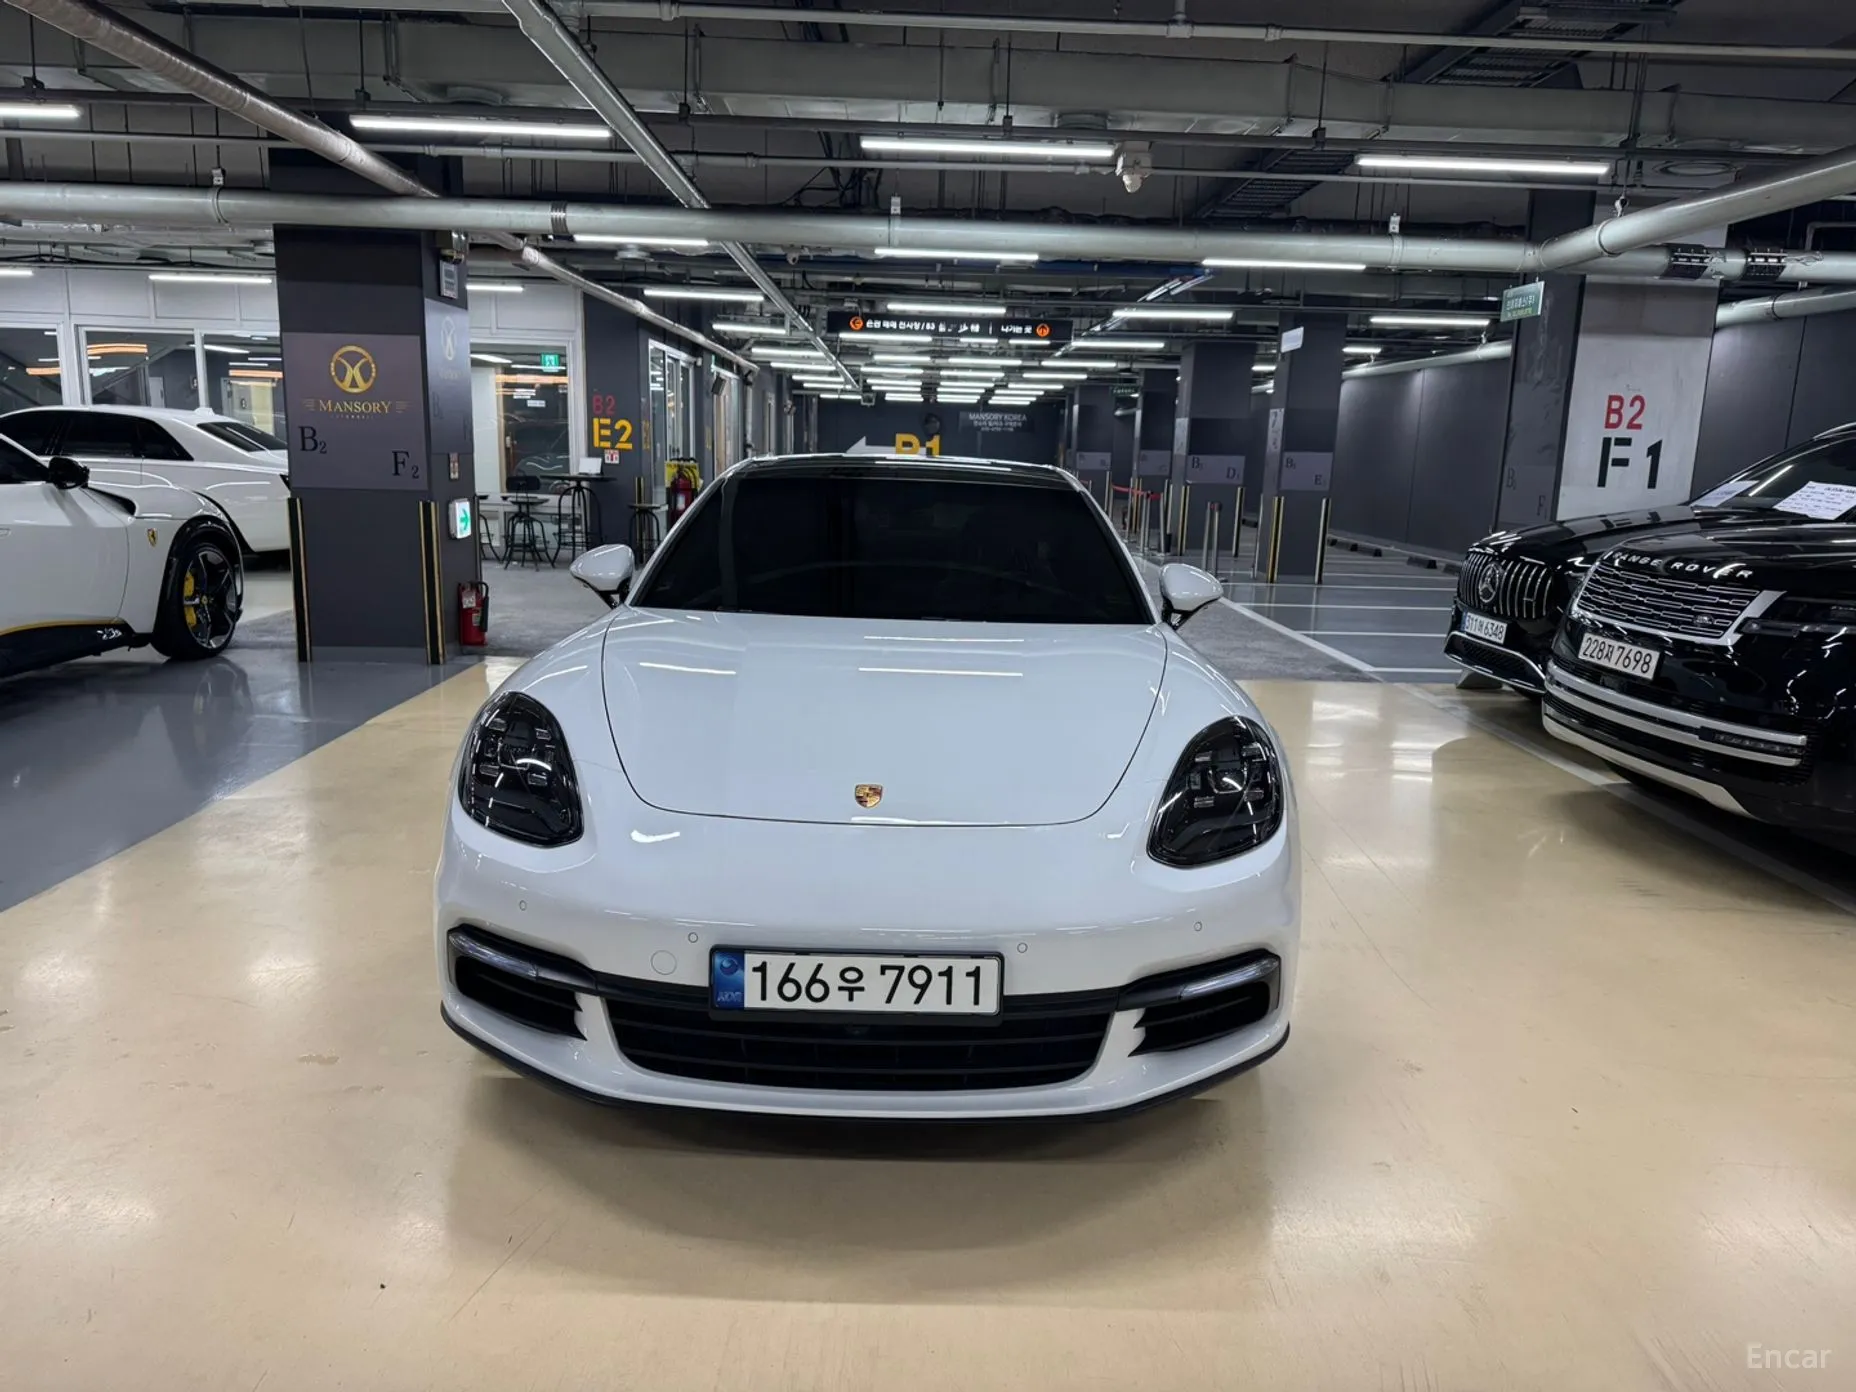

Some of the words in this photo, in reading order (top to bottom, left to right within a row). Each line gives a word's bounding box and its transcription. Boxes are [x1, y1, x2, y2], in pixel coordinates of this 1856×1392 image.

[318, 399, 392, 414] MANSORY
[592, 394, 616, 416] B2
[1604, 394, 1646, 430] B2
[298, 425, 328, 455] B2
[592, 417, 633, 450] E2
[391, 450, 420, 479] F2
[1597, 436, 1663, 490] F1
[1612, 551, 1663, 567] RANGE
[1670, 562, 1753, 579] ROVER
